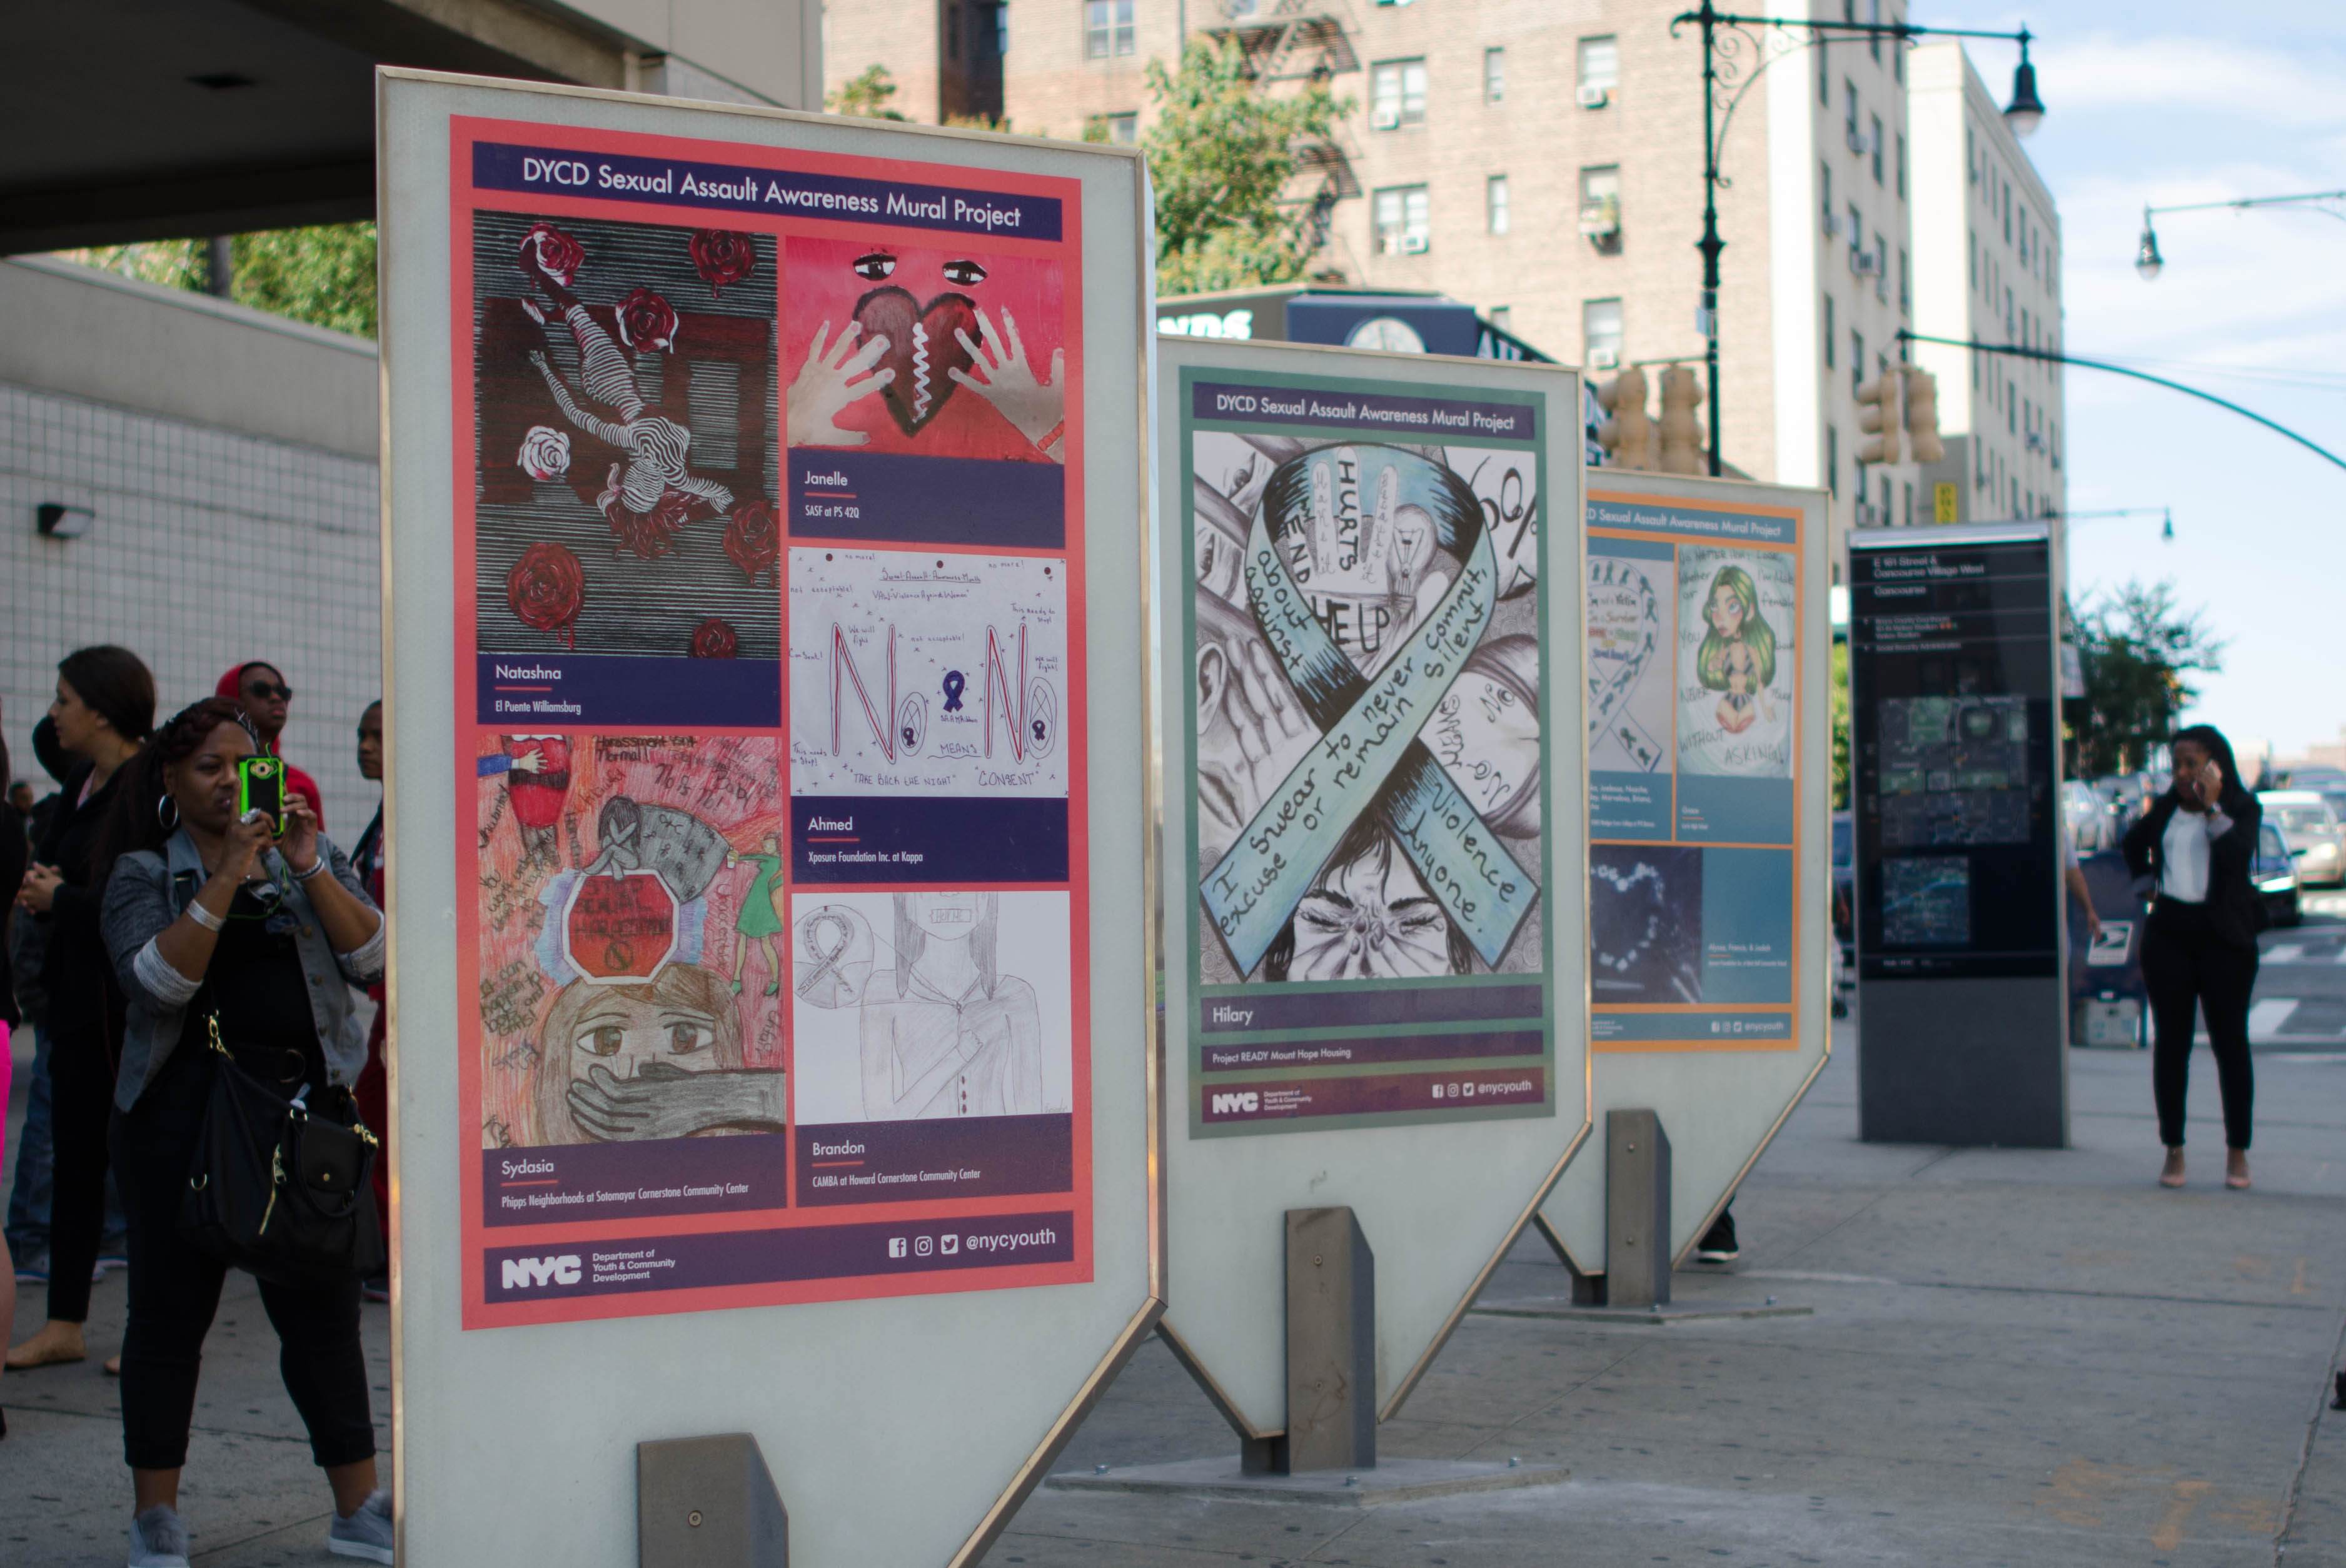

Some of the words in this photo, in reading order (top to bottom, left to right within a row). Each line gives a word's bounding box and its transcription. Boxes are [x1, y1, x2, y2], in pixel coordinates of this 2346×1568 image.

[523, 158, 590, 186] DYCD
[599, 165, 672, 194] Sexual
[680, 172, 757, 202] Assault
[765, 181, 878, 214] Awareness
[886, 192, 946, 220] Mural
[954, 199, 1021, 231] Project
[1216, 394, 1256, 413] DYCD
[1261, 396, 1305, 416] Sexual
[1309, 401, 1356, 420] Assault
[1360, 405, 1428, 425] Awareness
[1432, 409, 1469, 428] Mural
[1473, 411, 1514, 434] Project
[804, 470, 848, 486] Janelle
[805, 504, 823, 517] SASF
[824, 507, 832, 517] at
[833, 506, 843, 518] PS
[1337, 460, 1359, 571] HURTS
[1600, 508, 1631, 523] Sexual
[1634, 512, 1667, 526] Assault
[1669, 516, 1719, 531] Awareness
[1721, 520, 1748, 534] Mural
[1751, 522, 1781, 538] Project
[1874, 568, 1926, 579] Concourse
[1257, 550, 1314, 631] about
[1874, 585, 1927, 596] Concourse
[1244, 566, 1304, 671] against
[495, 664, 561, 680] Natashna
[495, 700, 503, 712] El
[505, 700, 531, 713] Puente
[532, 700, 581, 715] Williamsburg
[1212, 861, 1240, 903] I
[1250, 767, 1316, 855] swear
[1324, 732, 1352, 761] to
[1361, 657, 1414, 723] never
[808, 816, 853, 831] Ahmed
[1219, 852, 1287, 938] excuse
[1302, 795, 1323, 832] or
[1332, 697, 1414, 790] remain
[1432, 781, 1516, 903] Violence
[808, 852, 837, 865] Xposure
[838, 850, 877, 863] Foundation
[878, 851, 890, 862] Inc.
[892, 852, 900, 862] at
[902, 851, 924, 865] Kappa
[1212, 1005, 1254, 1026] Hilary
[1212, 1052, 1239, 1065] Project
[1241, 1051, 1269, 1062] READY
[1271, 1050, 1296, 1061] Mount
[1297, 1048, 1319, 1061] Hope
[1321, 1047, 1351, 1059] Housing
[1478, 1080, 1532, 1095] @nycyouth
[1212, 1092, 1259, 1114] NYC
[812, 1140, 865, 1156] Brandon
[501, 1158, 555, 1179] Sydasia
[812, 1175, 838, 1189] CAMBA
[840, 1177, 847, 1186] at
[849, 1172, 876, 1186] Howard
[877, 1172, 918, 1185] Cornerstone
[919, 1170, 958, 1184] Community
[959, 1168, 982, 1180] Center
[501, 1195, 527, 1210] Phipps
[529, 1190, 585, 1209] Neighborhoods
[586, 1192, 595, 1203] at
[596, 1189, 636, 1204] Sotomayor
[638, 1186, 682, 1200] Cornerstone
[683, 1184, 725, 1199] Community
[726, 1182, 749, 1194] Center
[965, 1228, 1057, 1252] @nycyouth
[593, 1250, 645, 1262] Department
[646, 1249, 655, 1259] of
[593, 1262, 618, 1273] Youth
[618, 1262, 625, 1270] &
[627, 1259, 676, 1272] Community
[501, 1255, 582, 1290] NYC
[593, 1271, 650, 1284] Development
